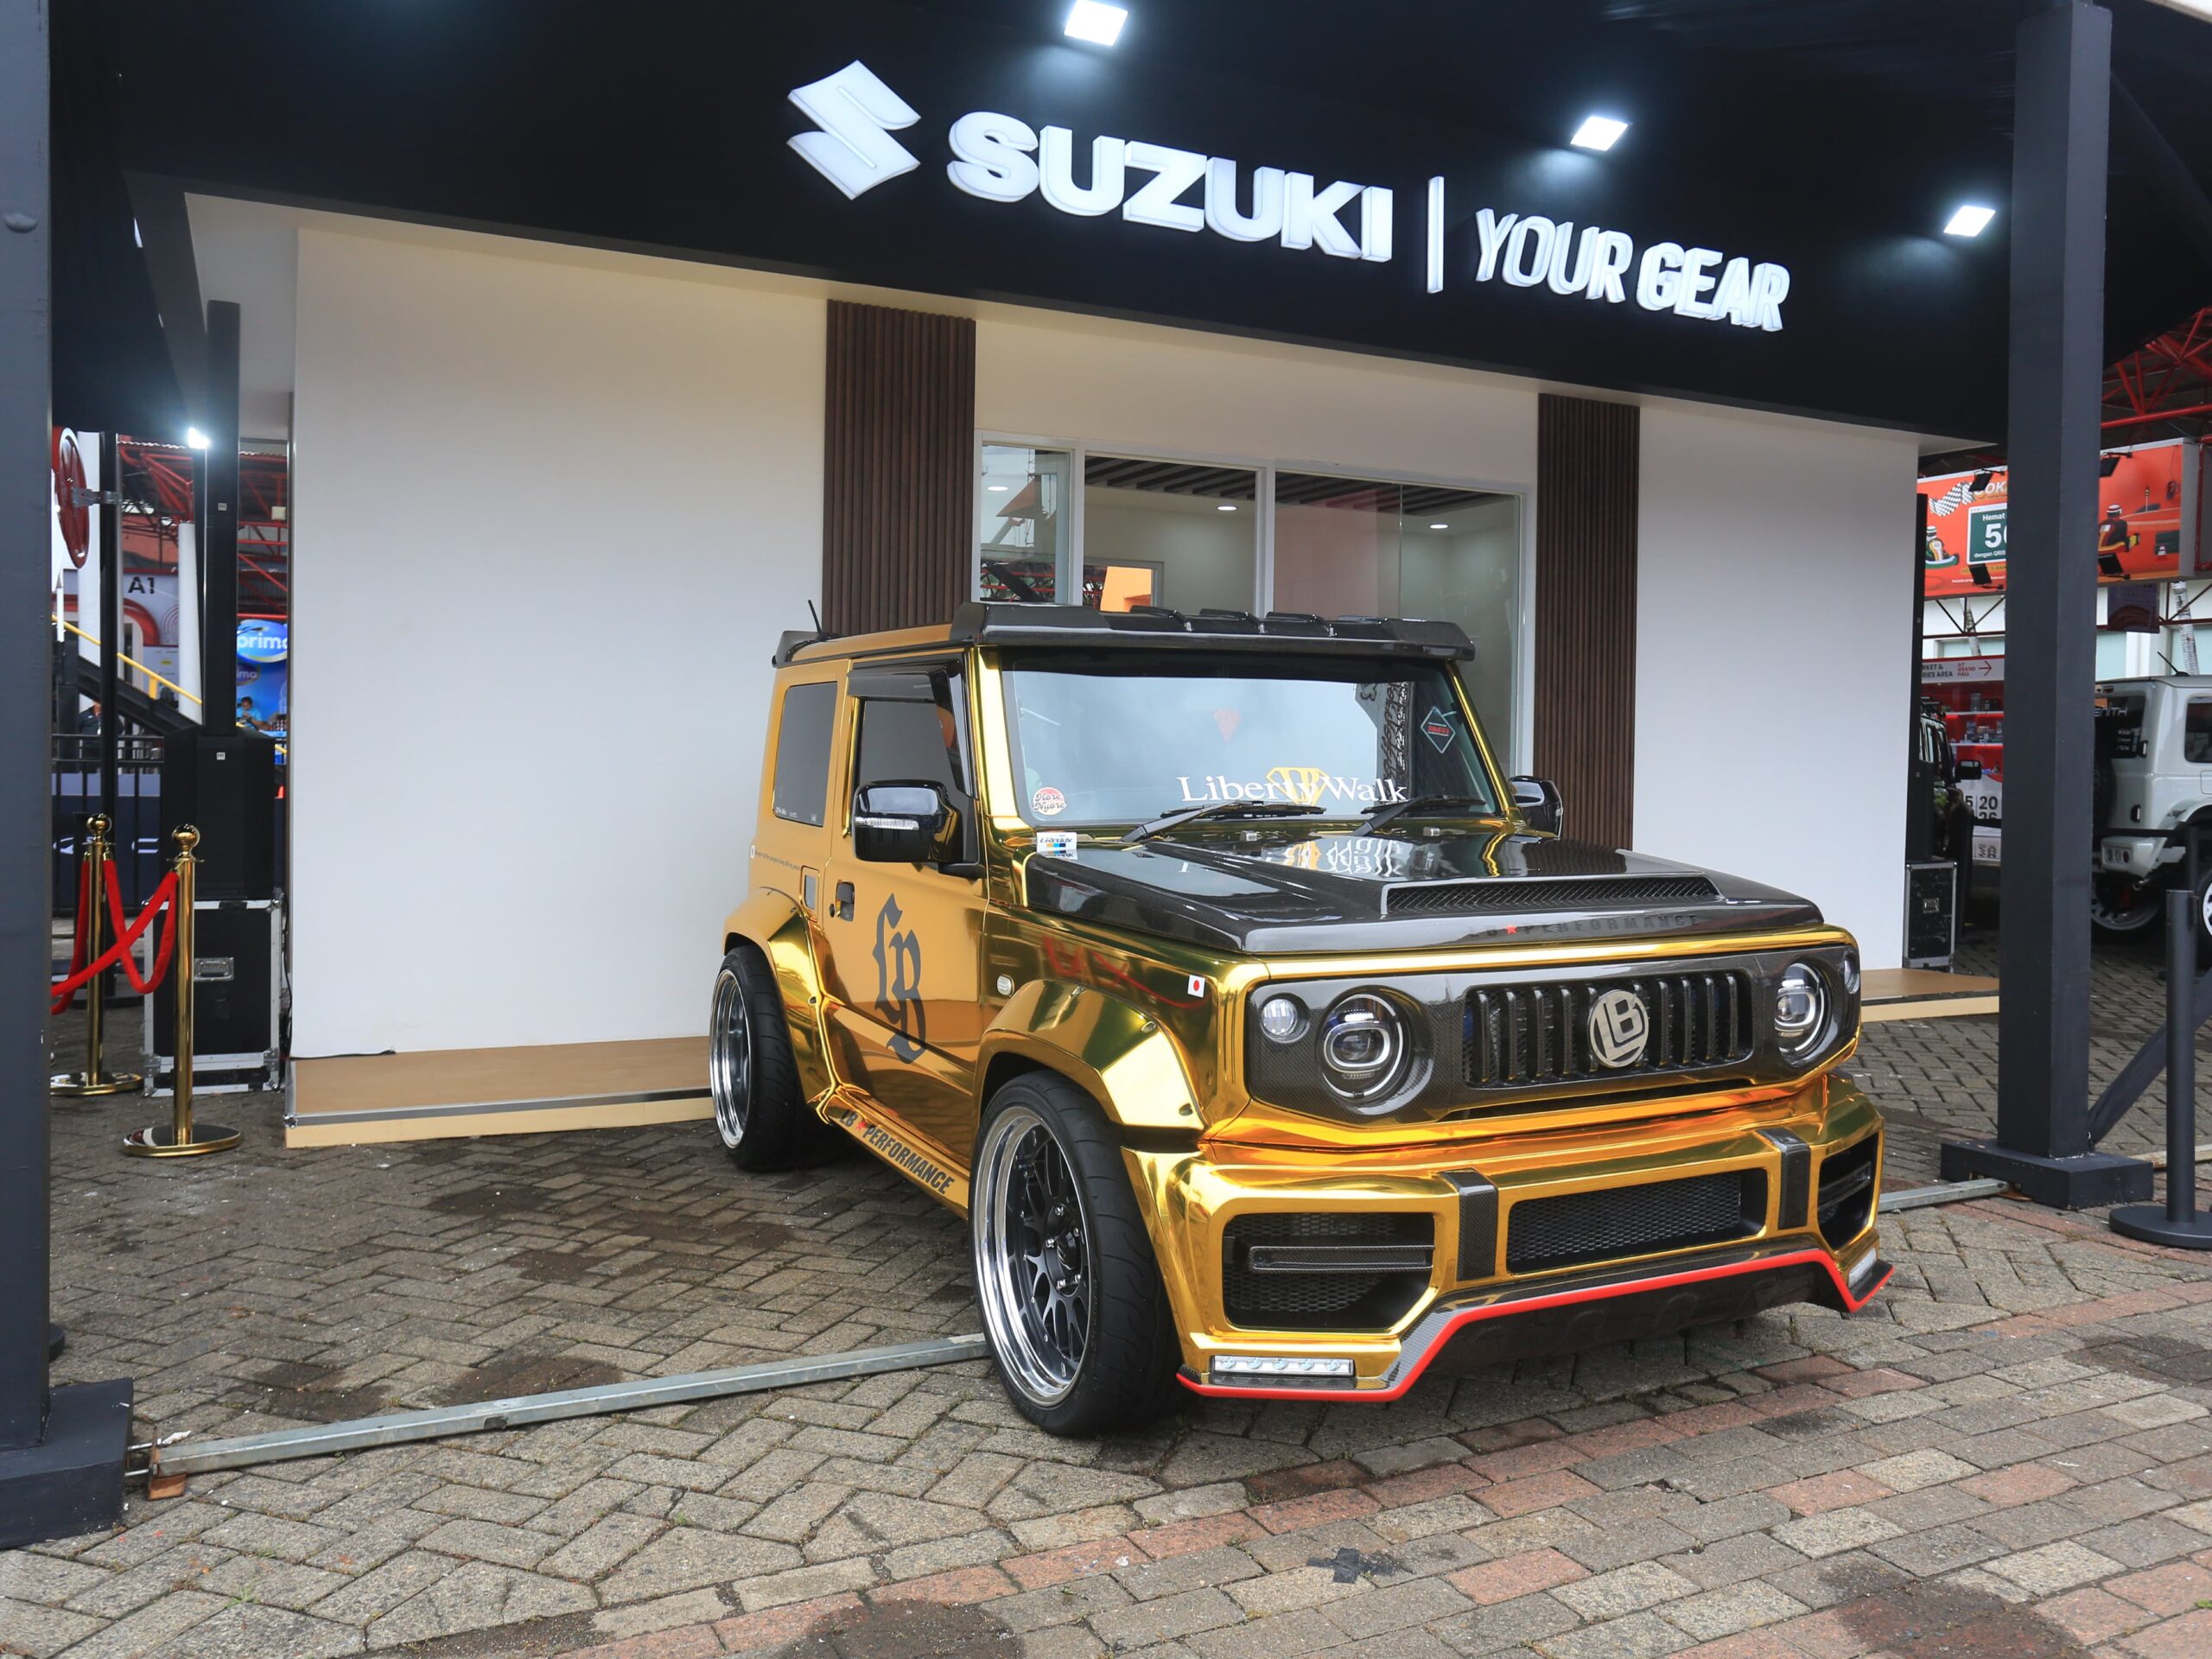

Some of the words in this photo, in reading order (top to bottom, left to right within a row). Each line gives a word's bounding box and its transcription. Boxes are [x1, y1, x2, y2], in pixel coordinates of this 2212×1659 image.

[947, 111, 1393, 262] SUZUKI
[1476, 208, 1633, 302] YOUR
[1637, 242, 1789, 332] GEAR
[128, 576, 155, 594] A1
[1176, 775, 1319, 804] Liberty
[1319, 777, 1408, 802] Walk
[1979, 796, 1998, 810] 20
[1523, 913, 1699, 935] PERFORMANCE
[839, 1109, 858, 1127] LB
[862, 1124, 956, 1195] PERFORMANCE
